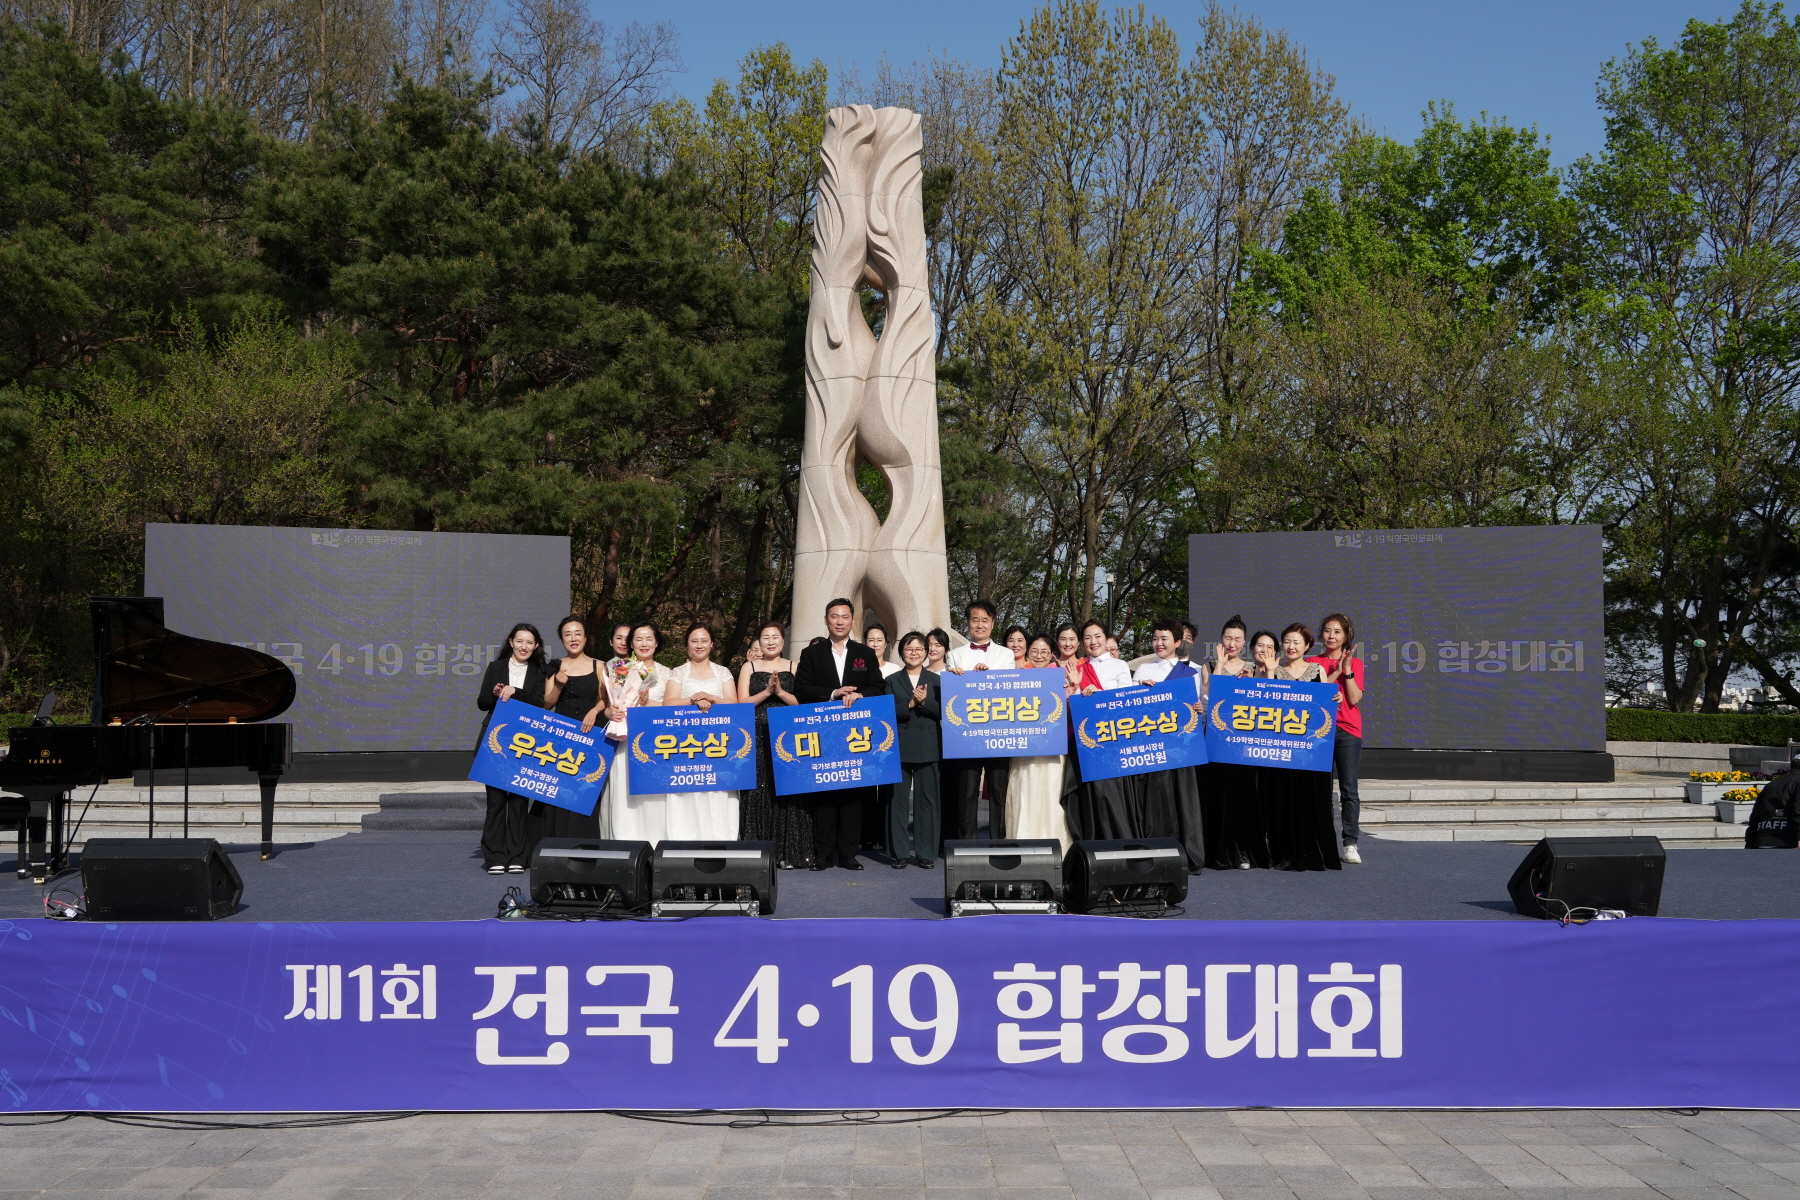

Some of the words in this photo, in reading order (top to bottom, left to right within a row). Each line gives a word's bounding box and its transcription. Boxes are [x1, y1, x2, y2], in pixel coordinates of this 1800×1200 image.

[317, 643, 404, 676] 4·19
[1437, 639, 1584, 673] 합창대회
[978, 682, 993, 691] 전국
[1246, 689, 1262, 698] 전국
[966, 696, 1041, 723] 장려상
[1108, 701, 1123, 710] 전국
[530, 719, 547, 731] 전국
[665, 718, 681, 727] 전국
[806, 716, 821, 725] 전국
[1095, 711, 1178, 743] 최우수상
[1232, 705, 1310, 735] 장려상
[654, 732, 729, 760] 우수상
[794, 731, 821, 758] 대
[846, 726, 872, 753] 상
[984, 737, 1028, 749] 100만원
[1119, 742, 1165, 755] 서울특별시장상
[509, 732, 586, 776] 우수상
[1120, 751, 1167, 769] 300만원
[1247, 747, 1292, 761] 100만원
[673, 764, 713, 773] 강북구청장상
[811, 759, 863, 771] 국가보훈부장관상
[520, 766, 559, 784] 강북구청장상
[669, 773, 717, 786] 200만원
[815, 768, 861, 784] 500만원
[511, 775, 560, 799] 200만원
[1756, 820, 1788, 831] STAFF
[284, 963, 437, 1021] 제1회
[473, 965, 680, 1066] 전국
[714, 964, 959, 1066] 4·19
[994, 962, 1402, 1064] 합창대회
